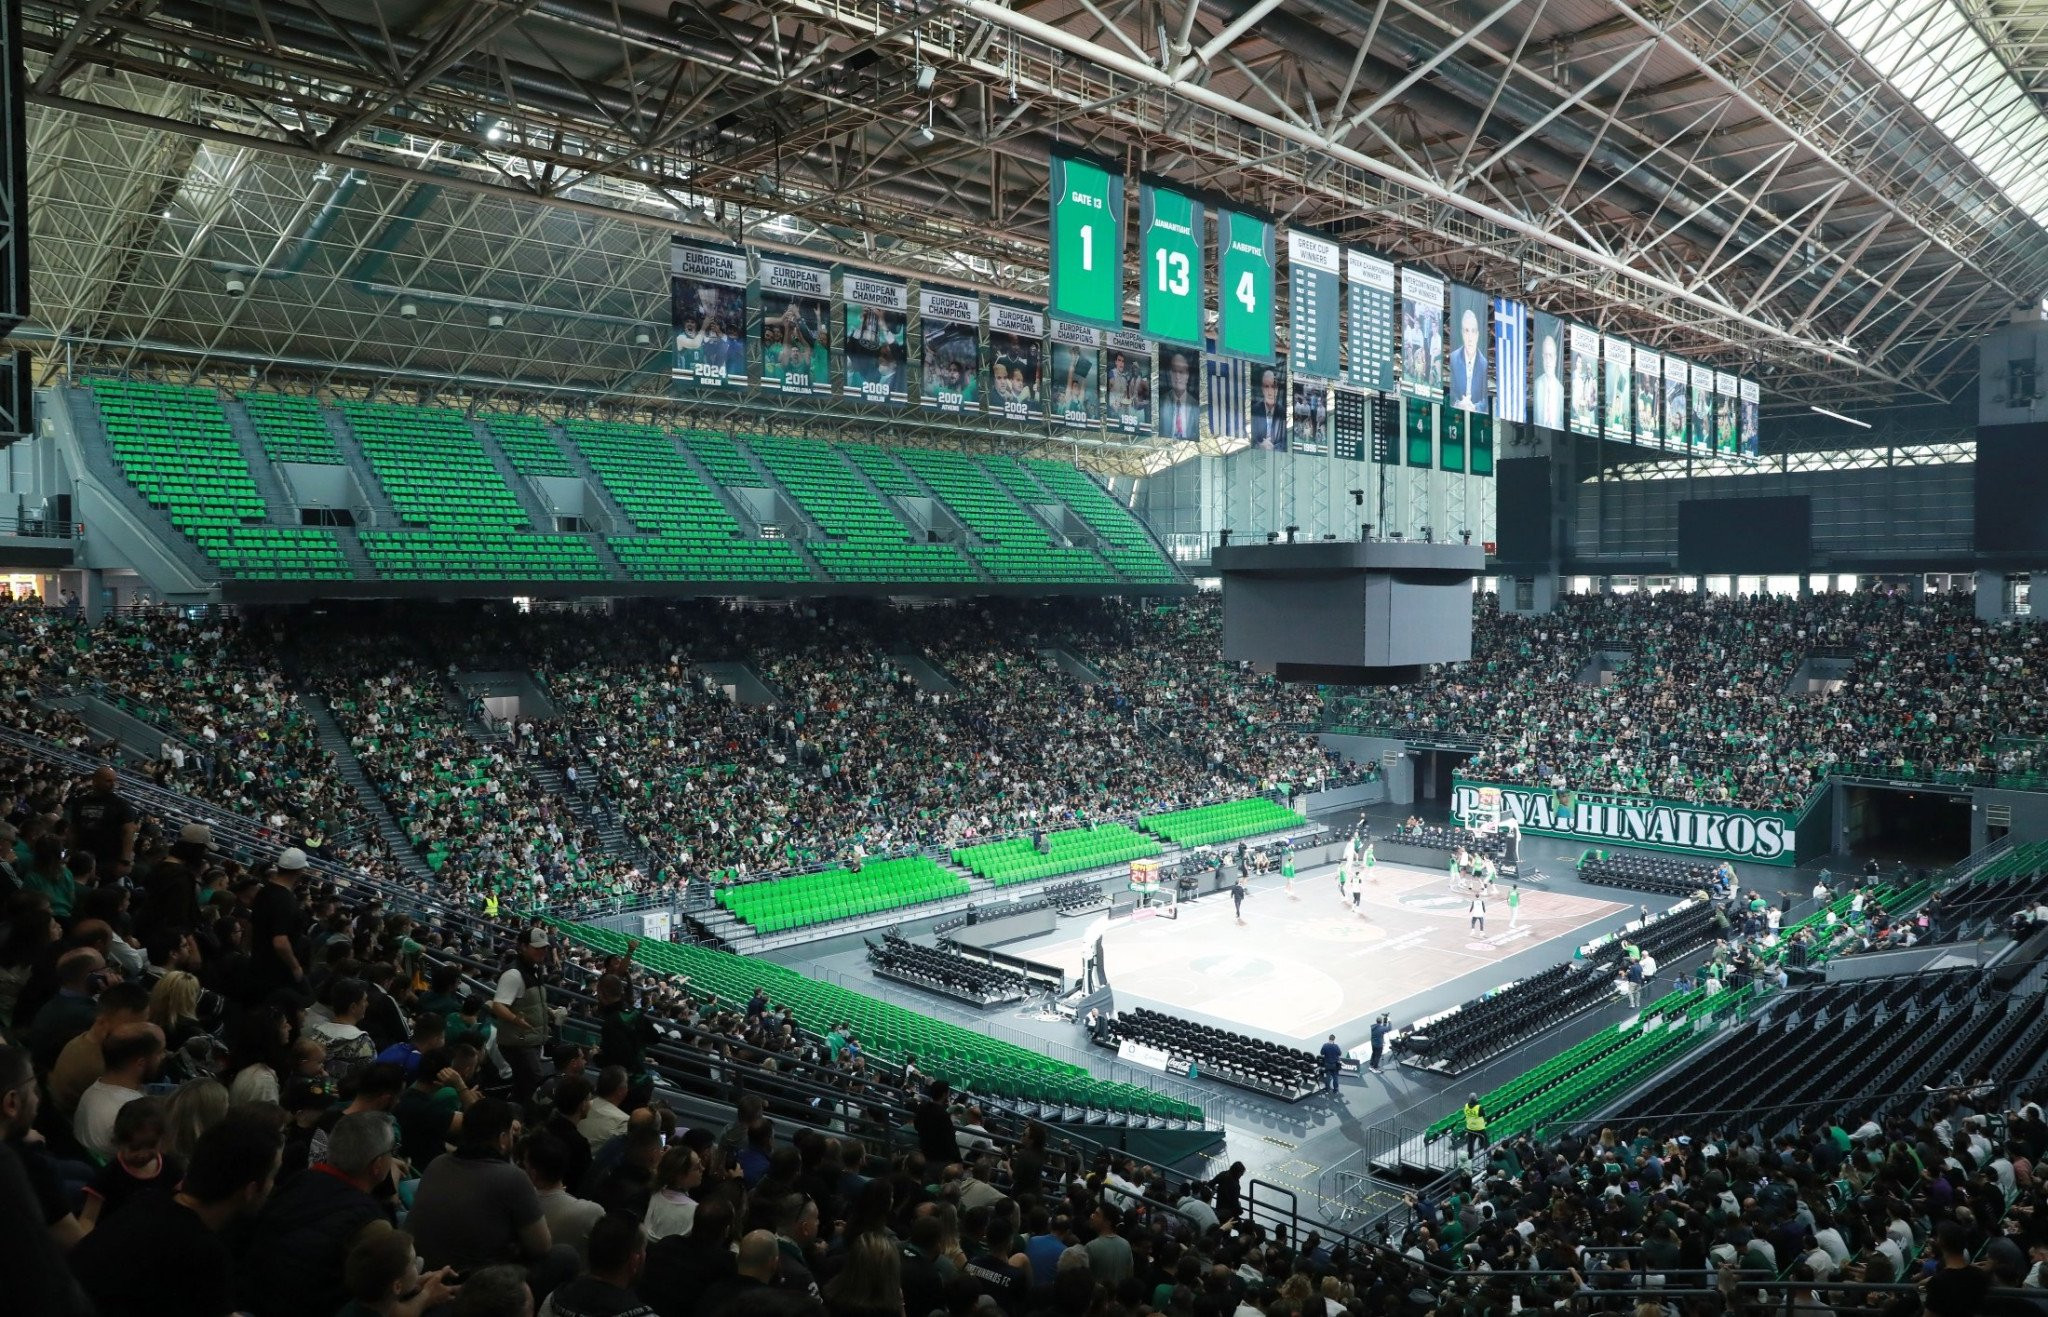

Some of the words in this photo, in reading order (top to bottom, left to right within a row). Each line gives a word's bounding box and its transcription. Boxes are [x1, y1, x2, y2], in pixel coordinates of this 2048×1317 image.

[1072, 191, 1092, 207] GATE
[1094, 197, 1102, 209] 13
[1080, 224, 1093, 271] 1
[1298, 238, 1317, 252] GREEK
[1318, 243, 1330, 254] CUP
[685, 252, 734, 271] EUROPEAN
[1300, 251, 1328, 266] WINNERS
[682, 262, 738, 281] CHAMPIONS
[773, 266, 818, 283] EUROPEAN
[1156, 248, 1190, 297] 13
[770, 277, 821, 293] CHAMPIONS
[855, 281, 896, 297] EUROPEAN
[1236, 271, 1256, 314] 4
[852, 290, 899, 307] CHAMPIONS
[931, 296, 968, 311] EUROPEAN
[928, 305, 971, 320] CHAMPIONS
[999, 310, 1034, 325] EUROPEAN
[996, 318, 1036, 334] CHAMPIONS
[1059, 322, 1091, 335] EUROPEAN
[1057, 330, 1093, 345] CHAMPIONS
[1113, 337, 1146, 351] CHAMPIONS
[694, 363, 727, 379] 2024
[785, 372, 809, 386] 2011
[862, 381, 890, 396] 2009
[938, 391, 963, 405] 2007
[1004, 402, 1028, 415] 2002
[1065, 410, 1087, 423] 2000
[1417, 418, 1424, 433] 4
[1448, 425, 1457, 440] 13
[1454, 785, 1786, 858] PNAHINAIKOS
